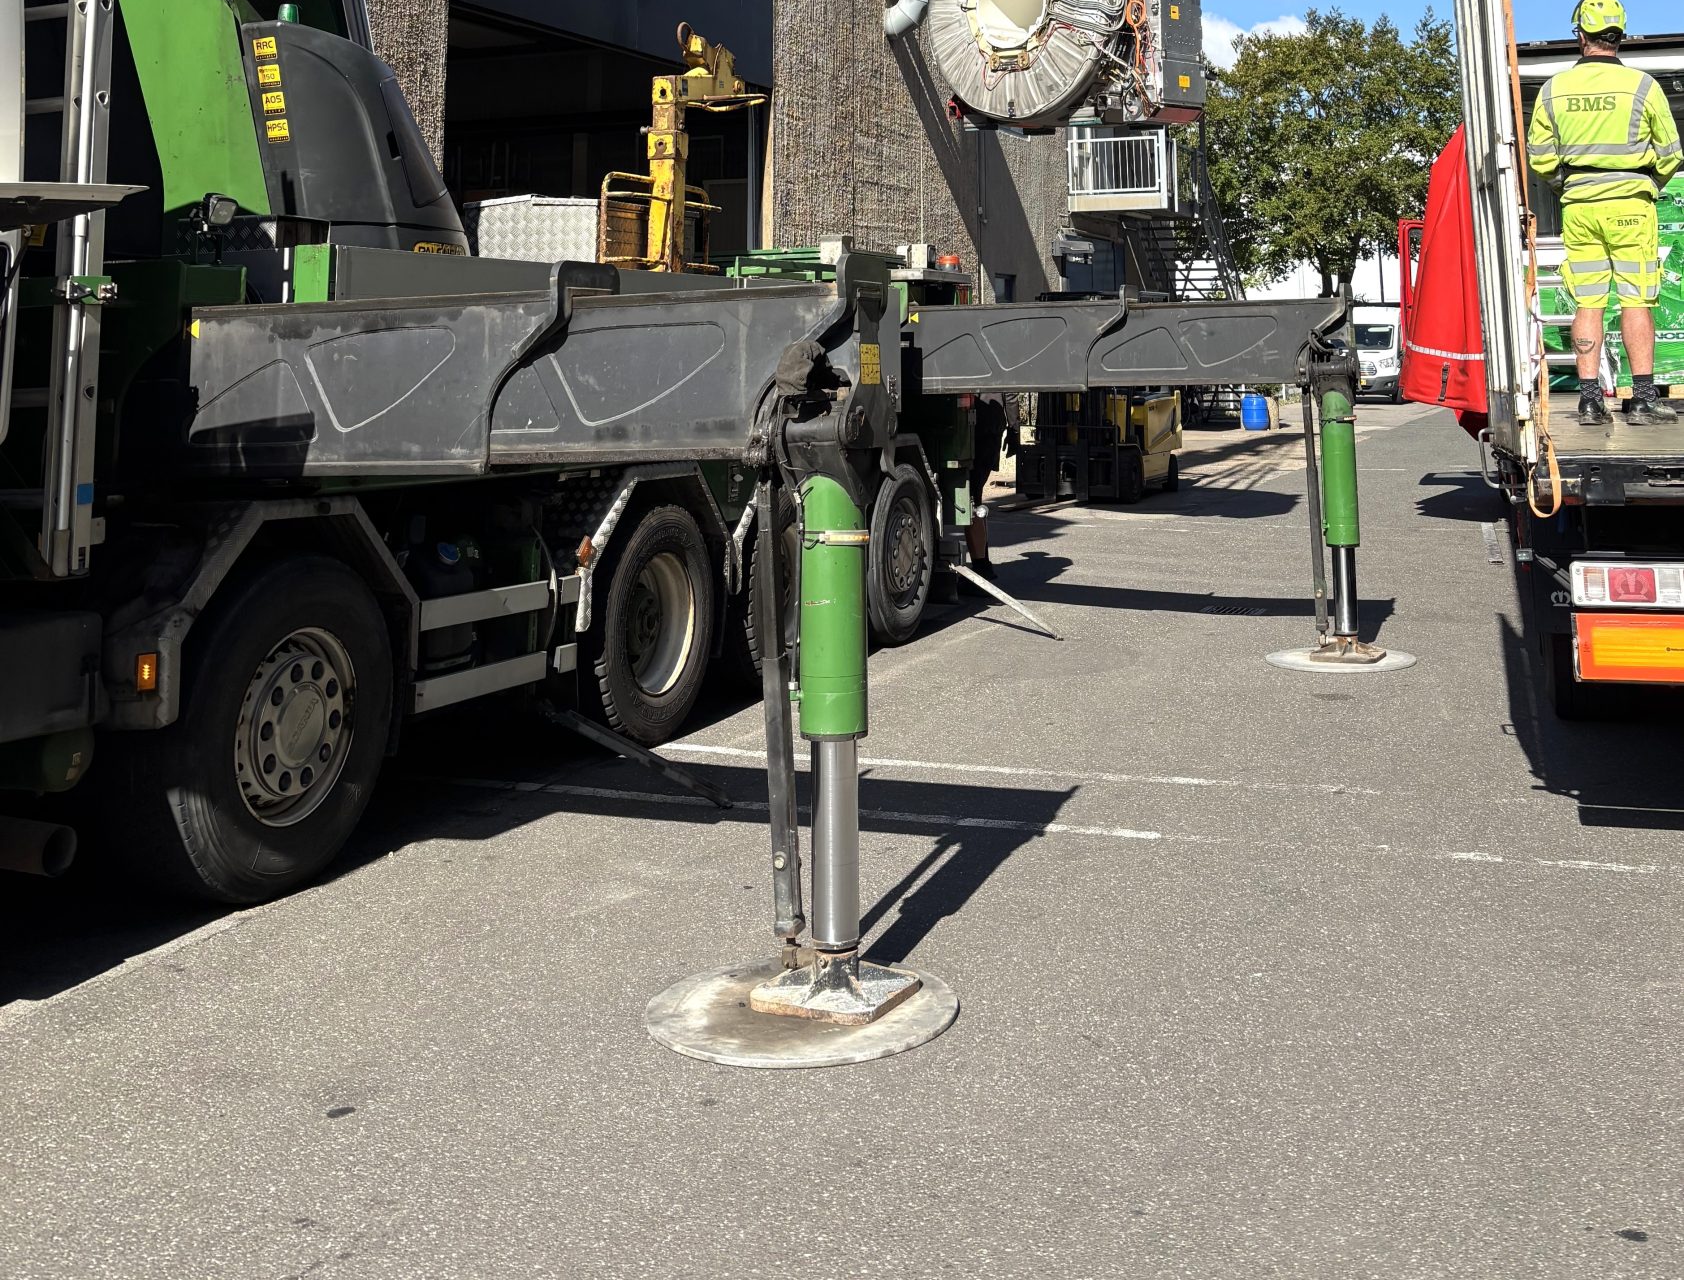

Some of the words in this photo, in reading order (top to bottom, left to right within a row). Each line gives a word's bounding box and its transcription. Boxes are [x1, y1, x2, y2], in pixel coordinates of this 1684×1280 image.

[256, 41, 273, 50] RRC
[1566, 96, 1616, 112] BMS
[268, 123, 287, 132] HPSC
